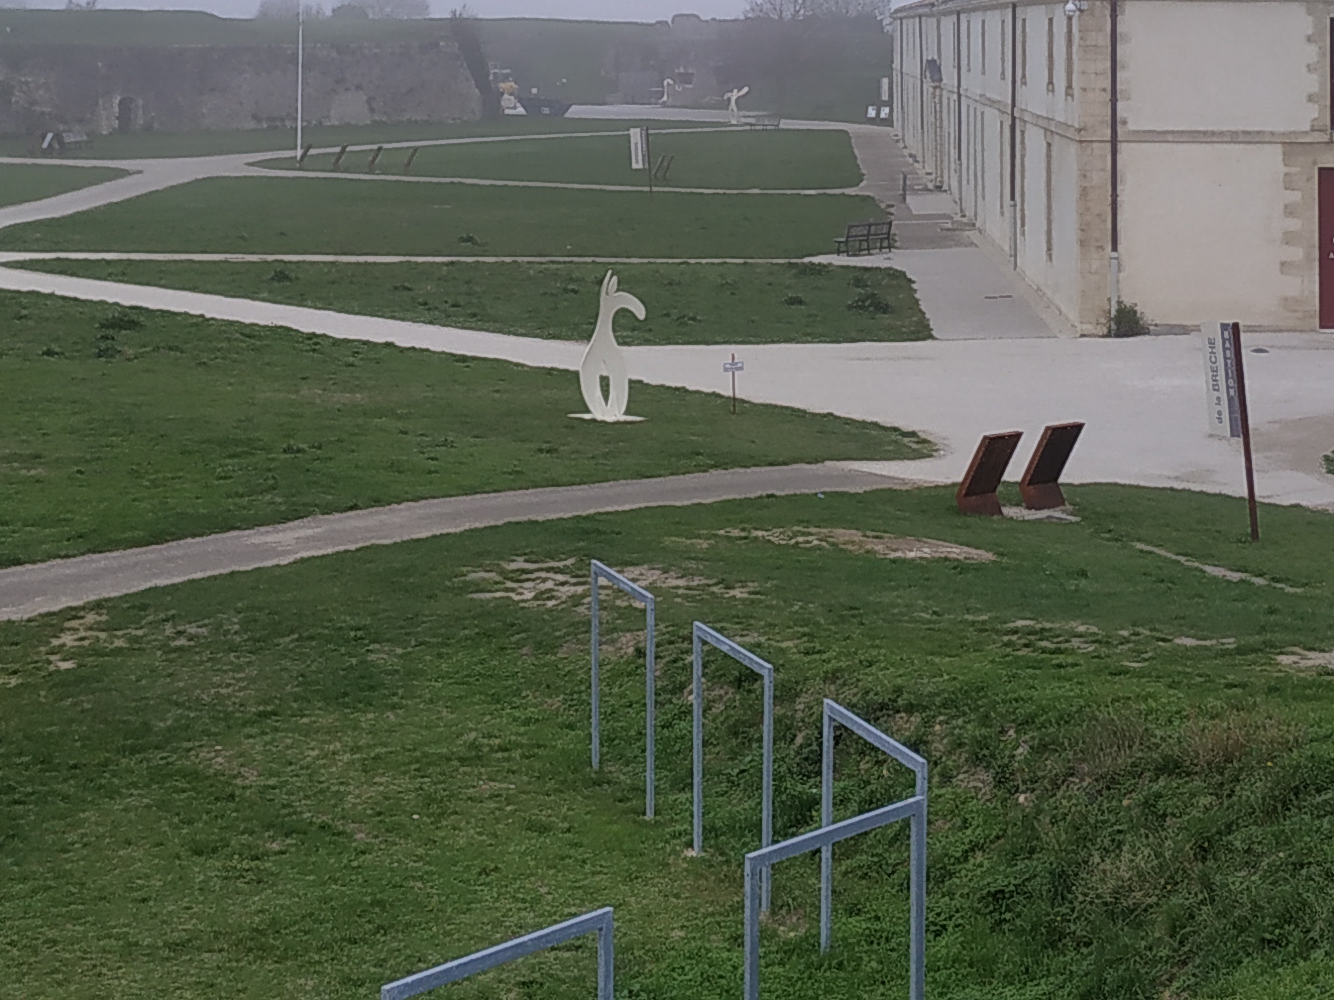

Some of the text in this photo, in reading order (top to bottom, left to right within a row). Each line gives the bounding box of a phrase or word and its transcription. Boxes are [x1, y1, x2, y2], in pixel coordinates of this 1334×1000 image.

[1208, 337, 1223, 424] de la BRECHE
[1224, 331, 1235, 396] BASTION
